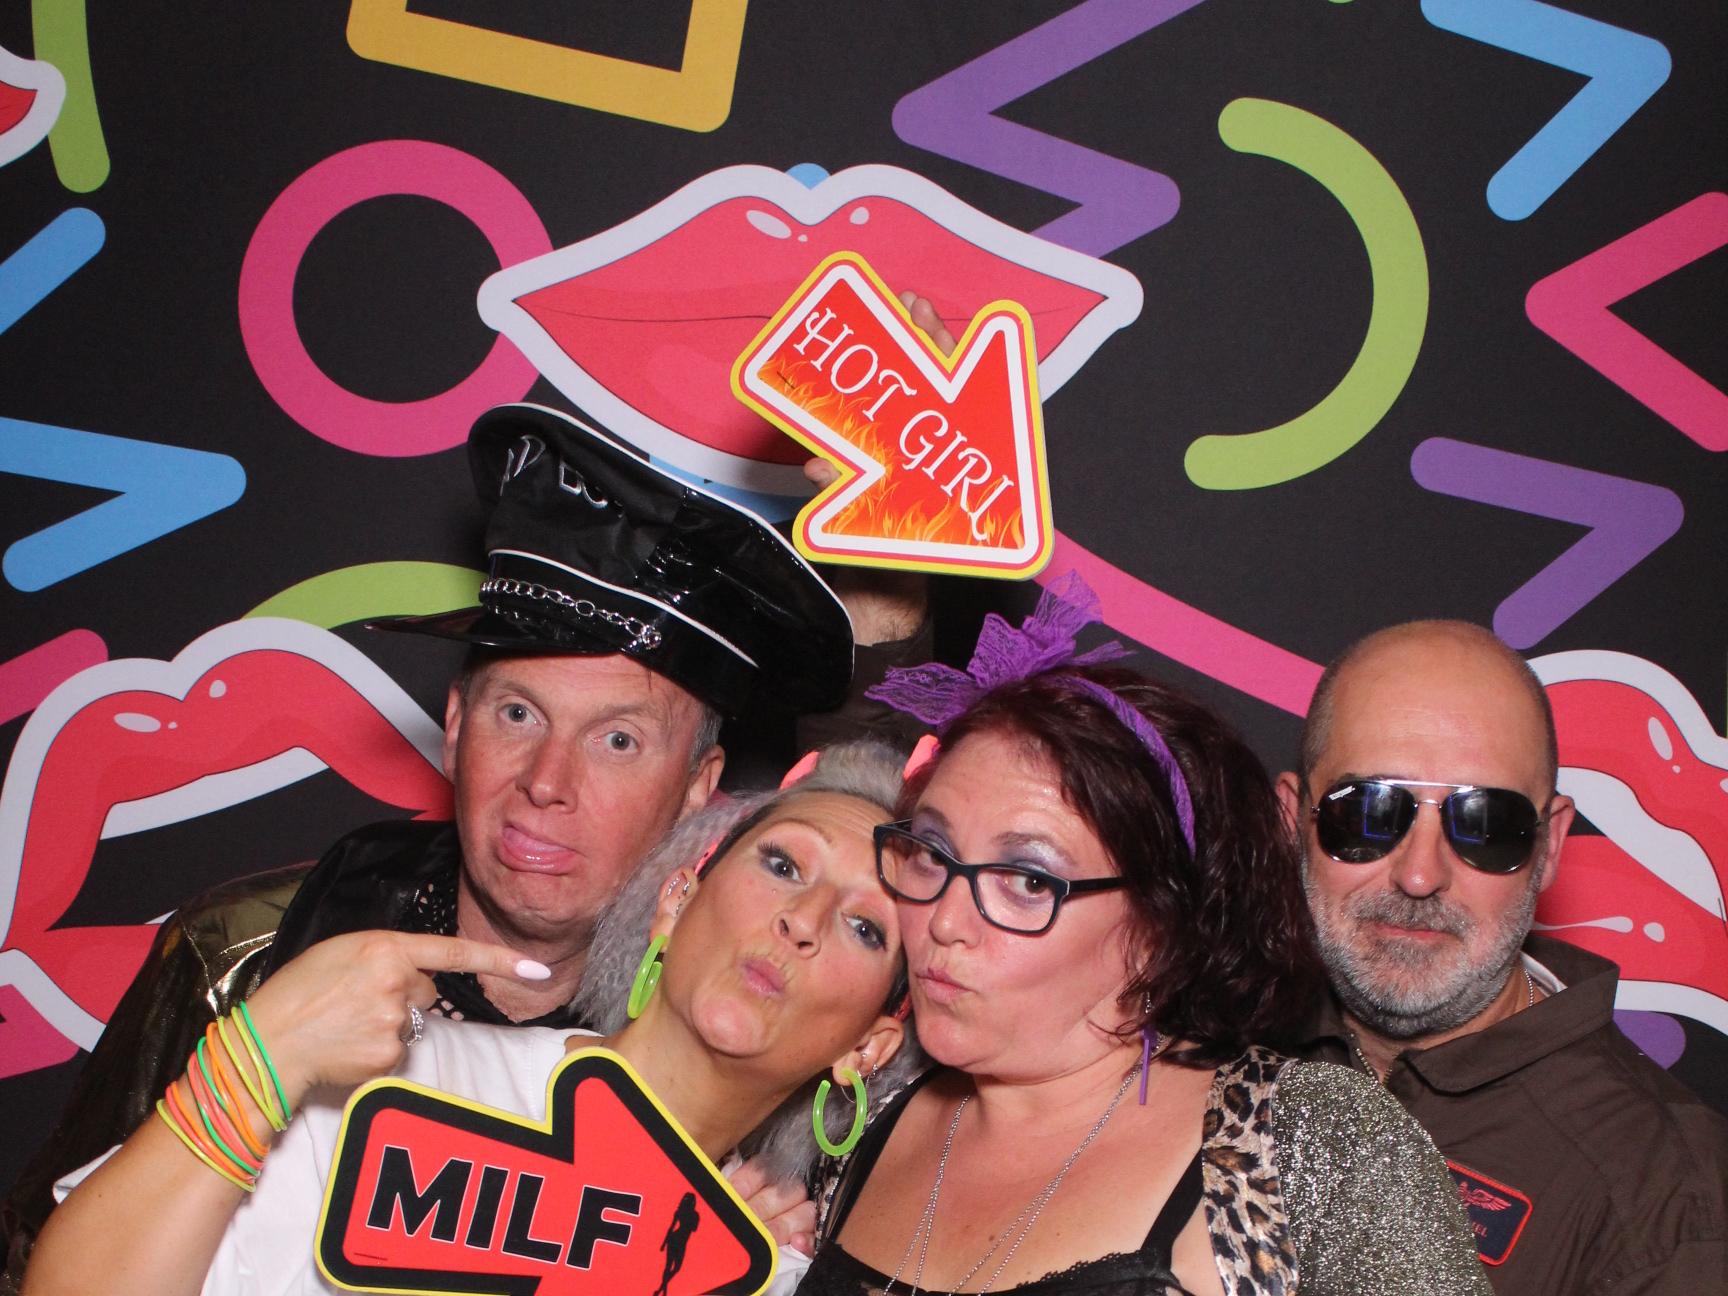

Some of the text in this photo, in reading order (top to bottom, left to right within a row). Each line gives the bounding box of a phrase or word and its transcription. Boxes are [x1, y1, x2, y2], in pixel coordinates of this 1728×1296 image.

[793, 307, 1014, 541] HOT GIRL
[365, 1144, 643, 1271] MILF
